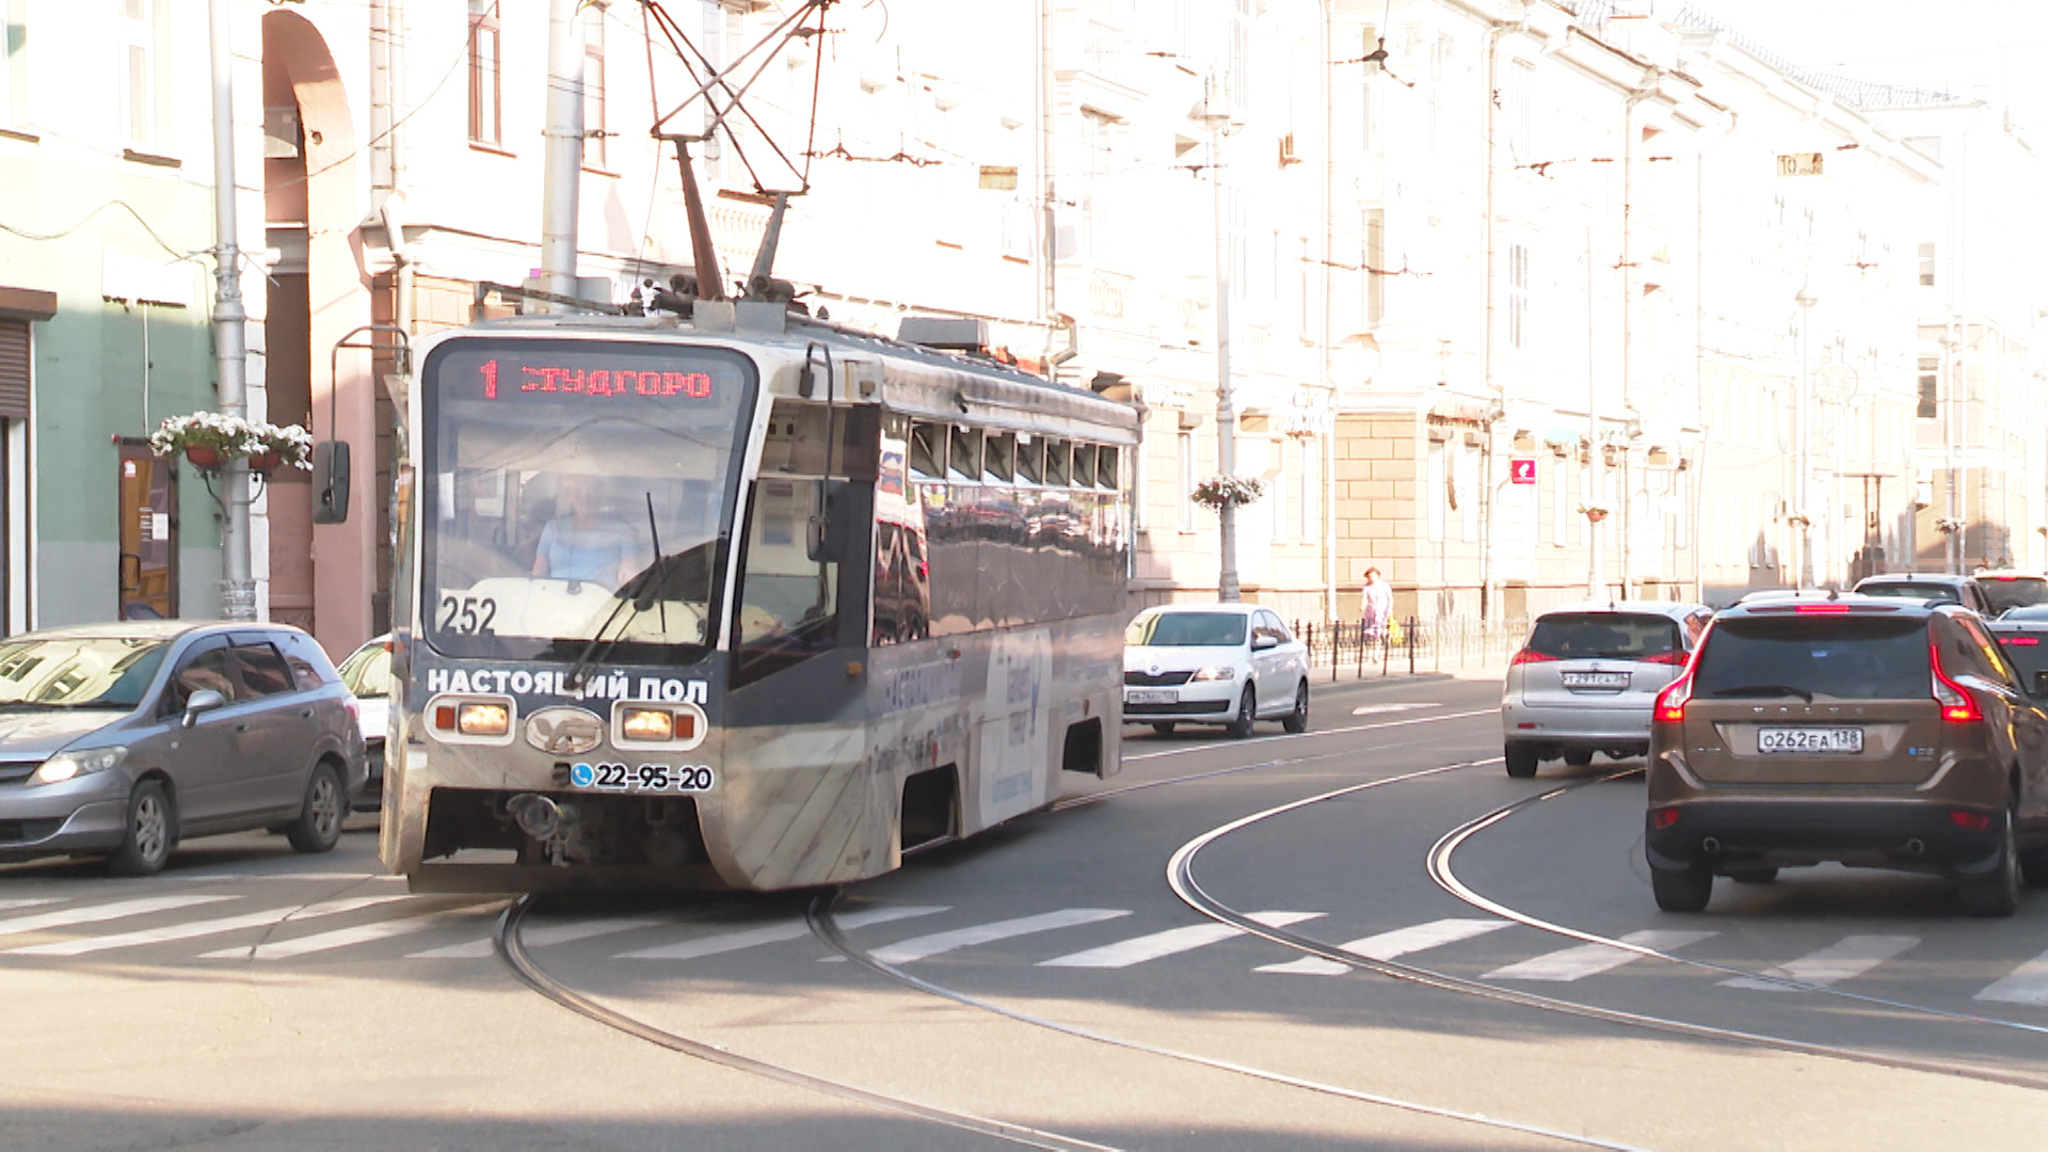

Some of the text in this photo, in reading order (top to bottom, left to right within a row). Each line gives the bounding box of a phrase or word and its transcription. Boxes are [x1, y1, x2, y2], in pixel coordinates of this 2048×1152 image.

[480, 359, 498, 399] 1
[441, 596, 496, 636] 252
[639, 677, 708, 704] ПОЛ
[596, 764, 712, 790] 22-95-20
